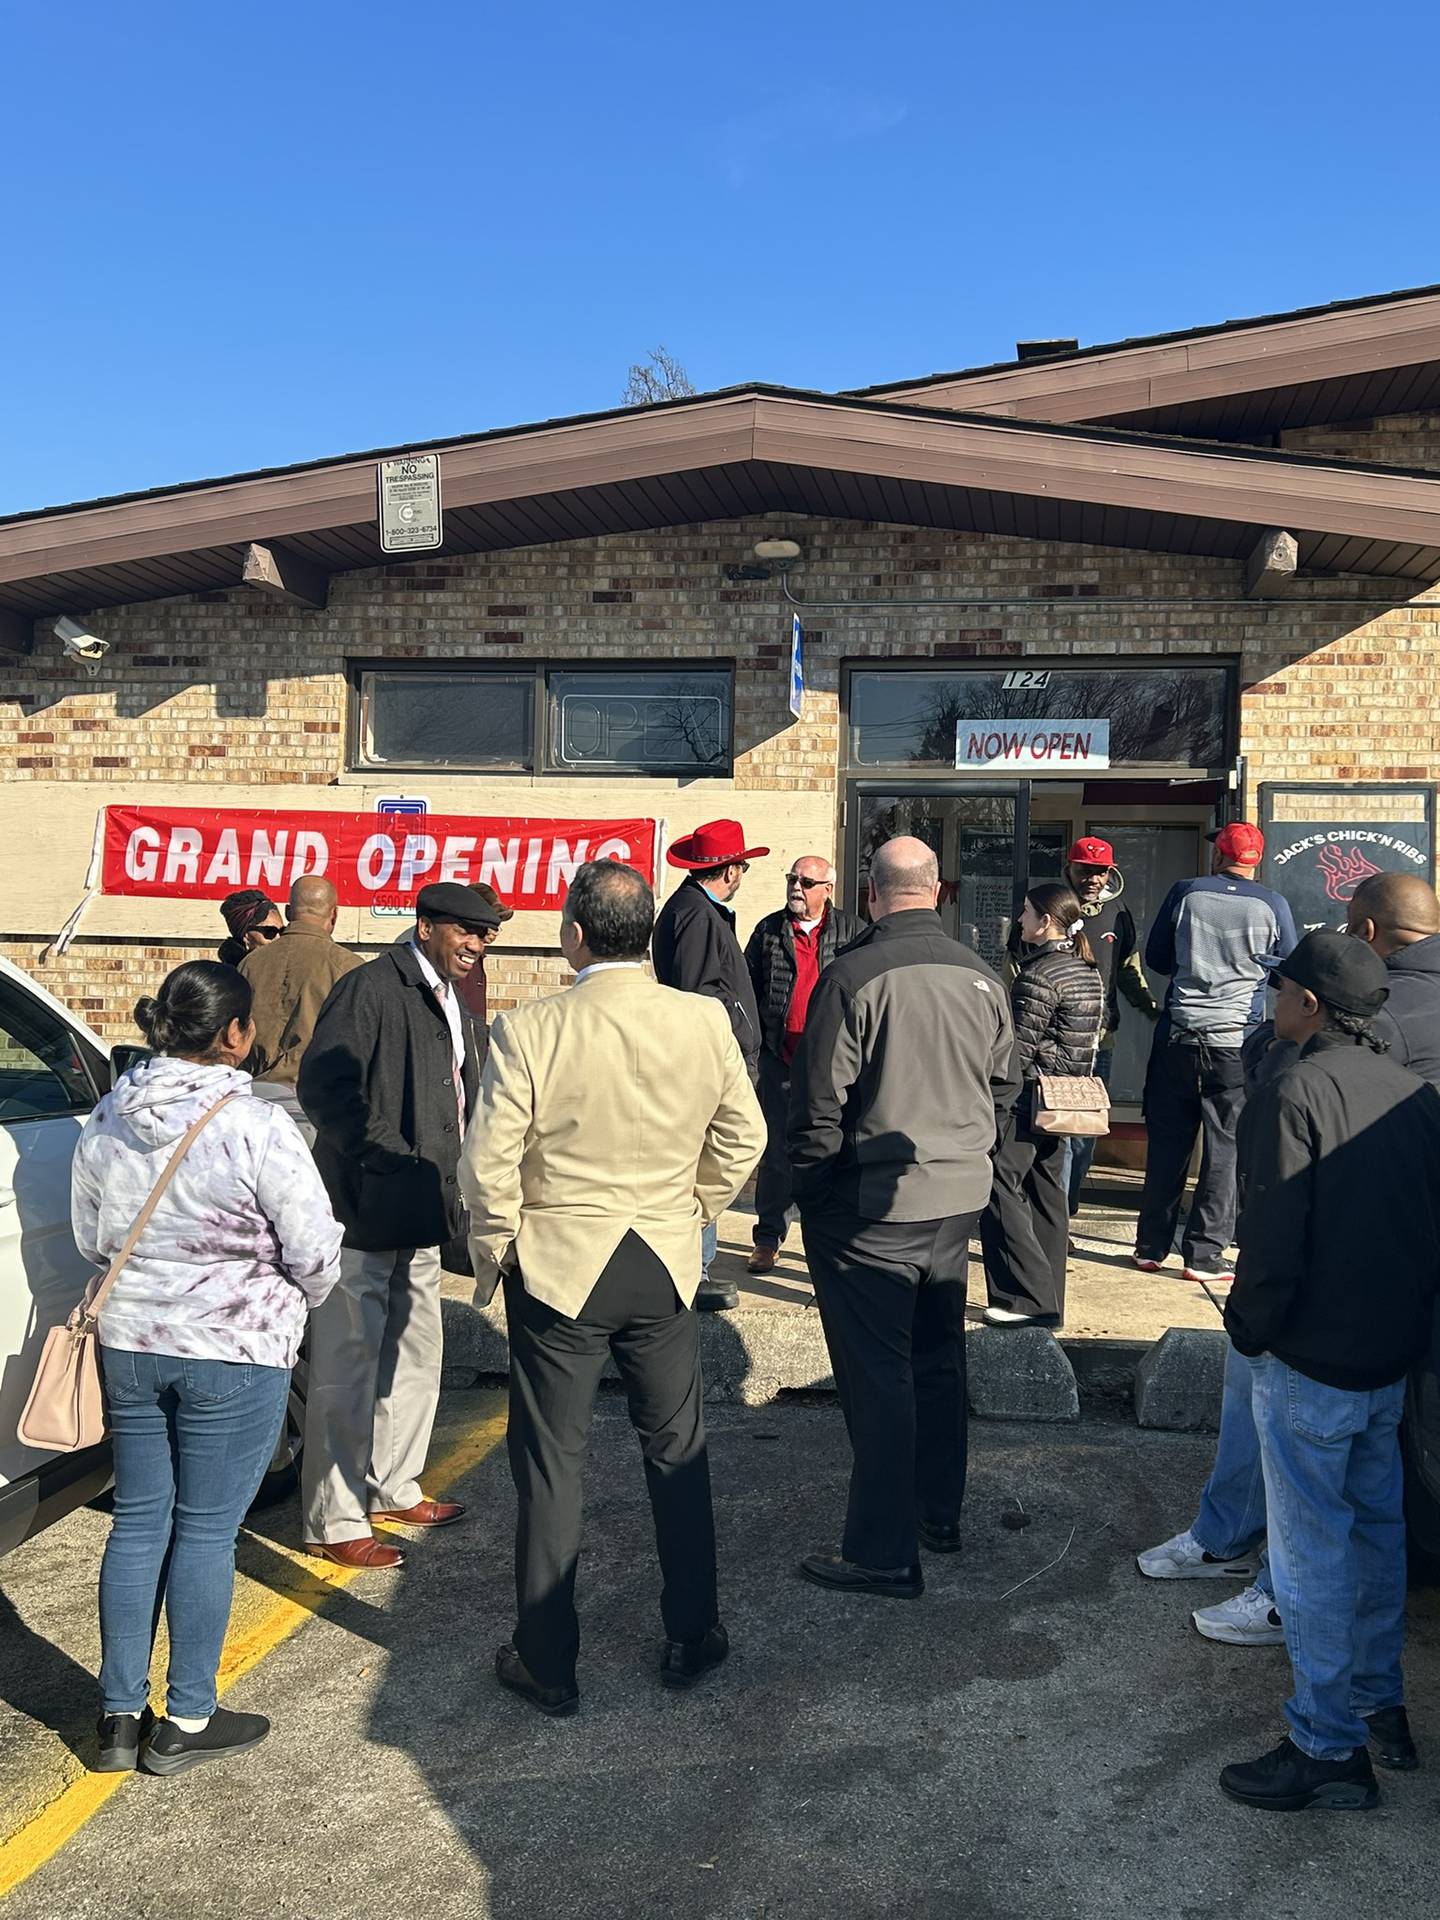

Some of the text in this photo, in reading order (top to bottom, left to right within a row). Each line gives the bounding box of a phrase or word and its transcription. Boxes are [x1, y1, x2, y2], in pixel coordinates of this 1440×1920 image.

[385, 472, 435, 484] TRESPASSING
[401, 464, 418, 475] NO
[1007, 671, 1050, 688] 124
[966, 732, 1092, 760] NOW OPEN
[124, 826, 330, 887] GRAND
[1273, 830, 1428, 866] JACK'S CHICK'N RIBS
